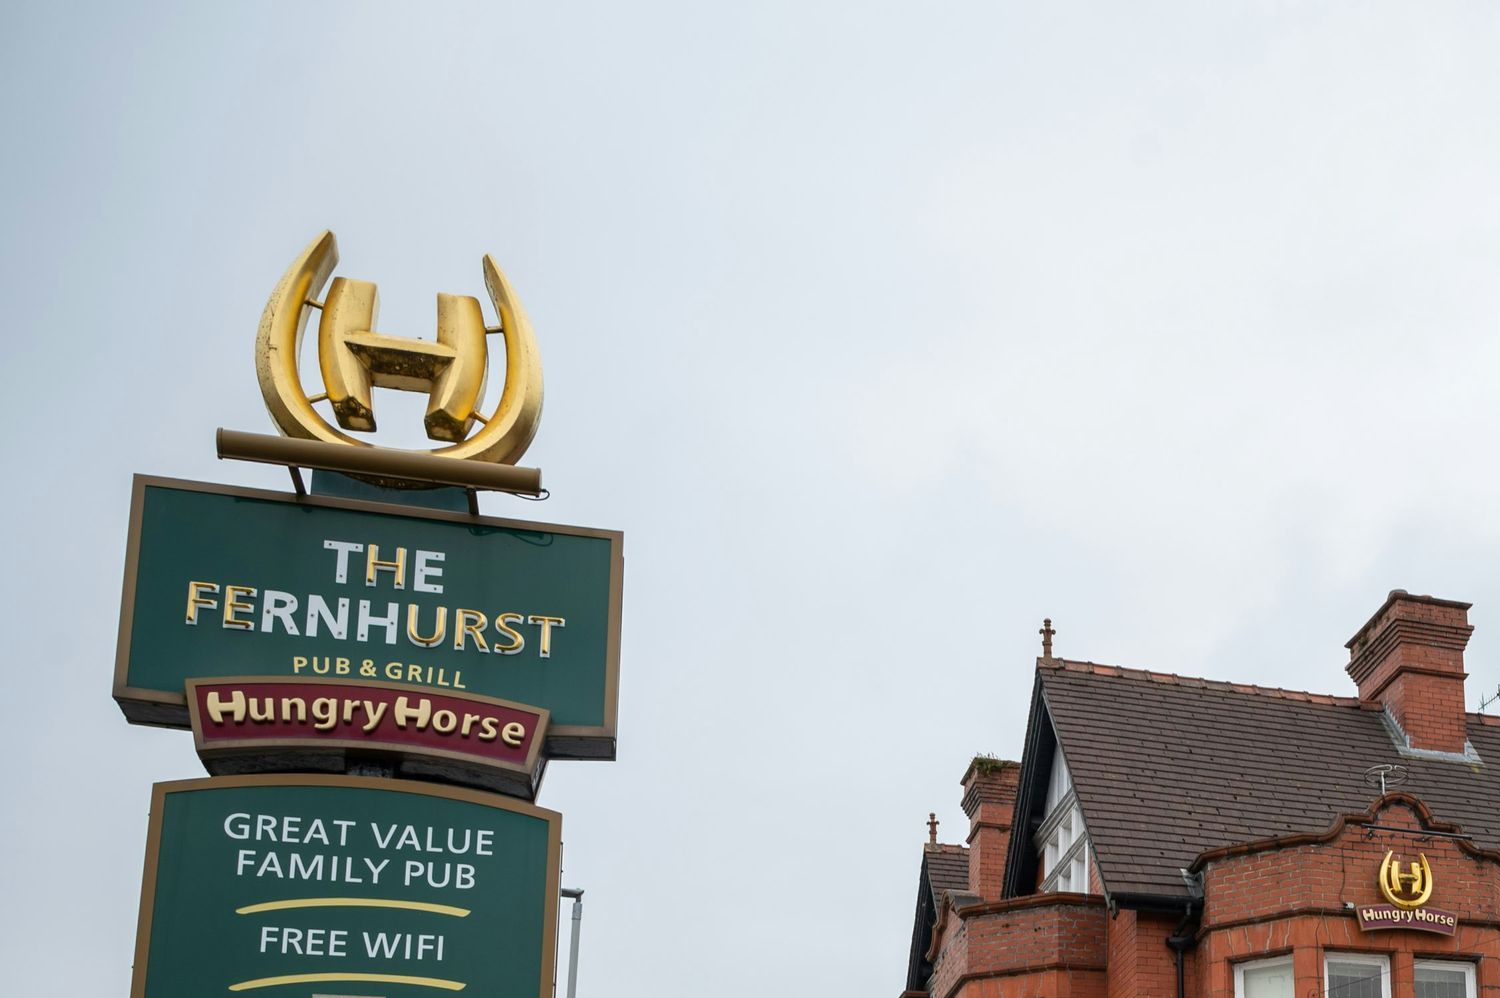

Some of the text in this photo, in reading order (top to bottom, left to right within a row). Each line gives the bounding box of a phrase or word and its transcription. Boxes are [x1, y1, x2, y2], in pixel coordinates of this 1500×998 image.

[323, 539, 446, 594] THE
[186, 580, 566, 659] FERNHURST
[293, 655, 467, 690] PUB & GRILL
[223, 812, 495, 856] GREAT VALUE
[236, 849, 477, 889] FAMILY PUB
[259, 926, 445, 961] FREE WIFI
